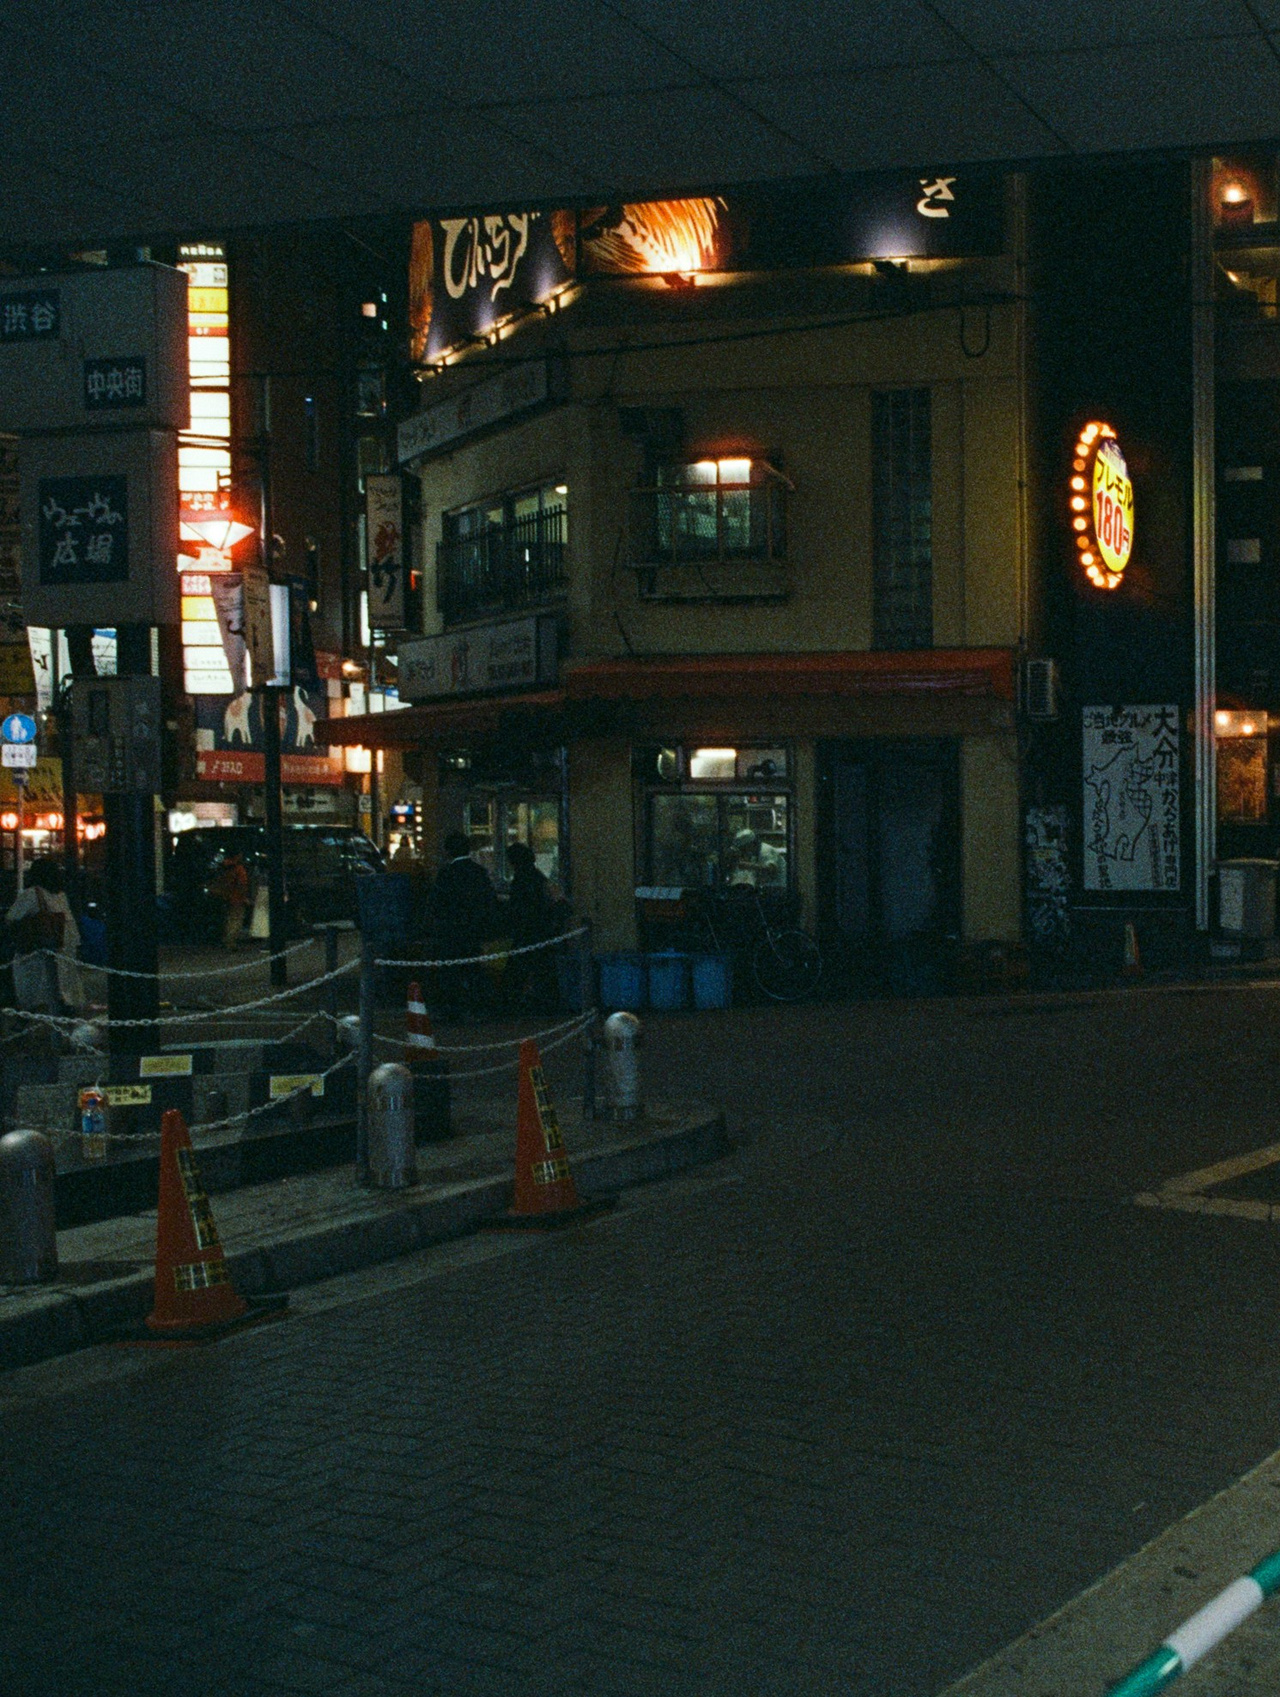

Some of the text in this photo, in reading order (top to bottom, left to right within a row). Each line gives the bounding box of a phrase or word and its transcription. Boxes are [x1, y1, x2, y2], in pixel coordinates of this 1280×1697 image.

[4, 301, 56, 333] 渋谷
[87, 367, 142, 400] 中央街
